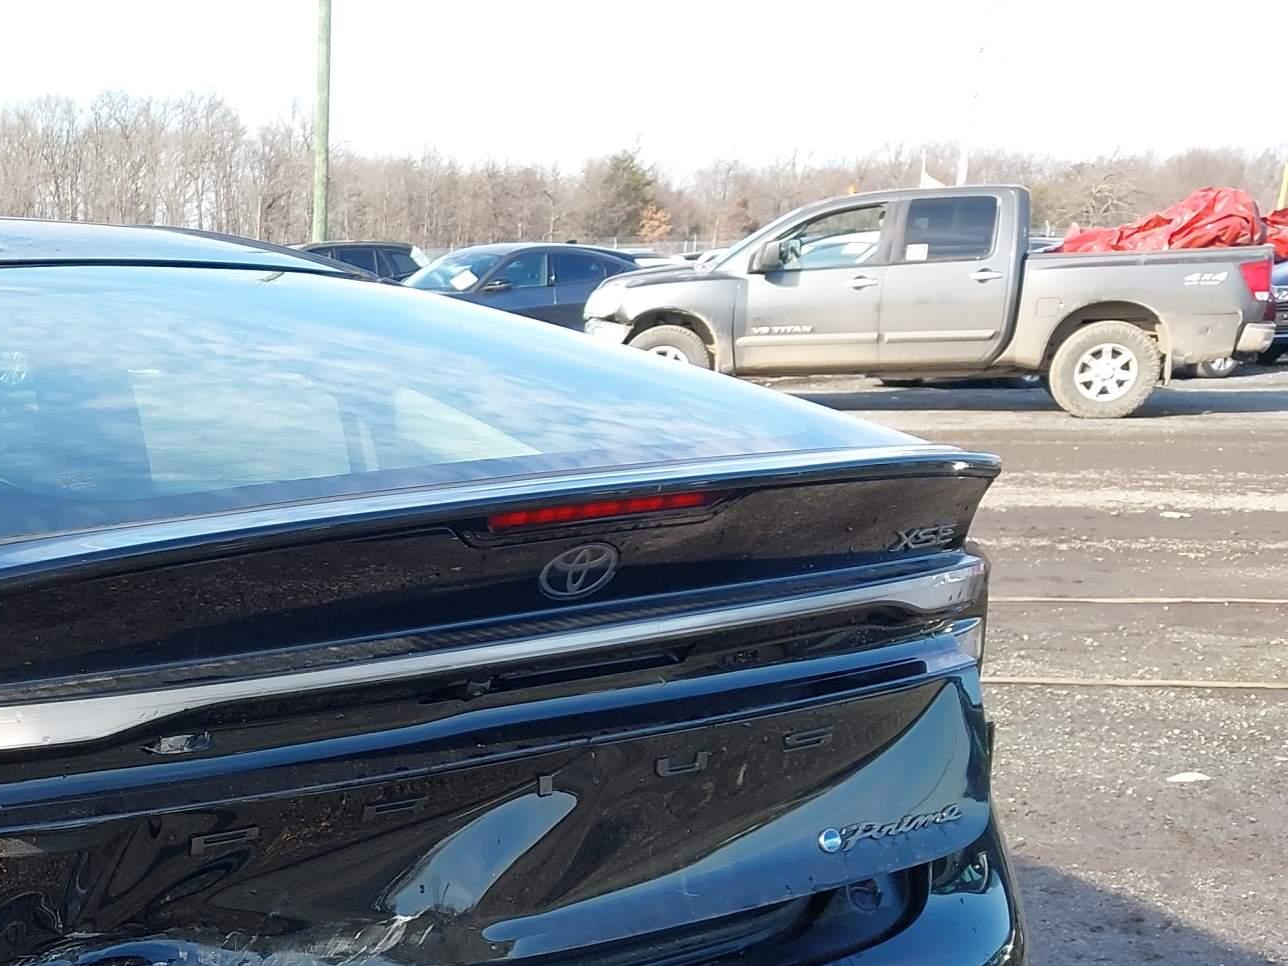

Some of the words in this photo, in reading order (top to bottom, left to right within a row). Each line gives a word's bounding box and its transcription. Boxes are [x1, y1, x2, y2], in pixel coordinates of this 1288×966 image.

[772, 325, 813, 335] TITAN
[890, 523, 958, 552] XSE
[842, 803, 963, 852] Prime
